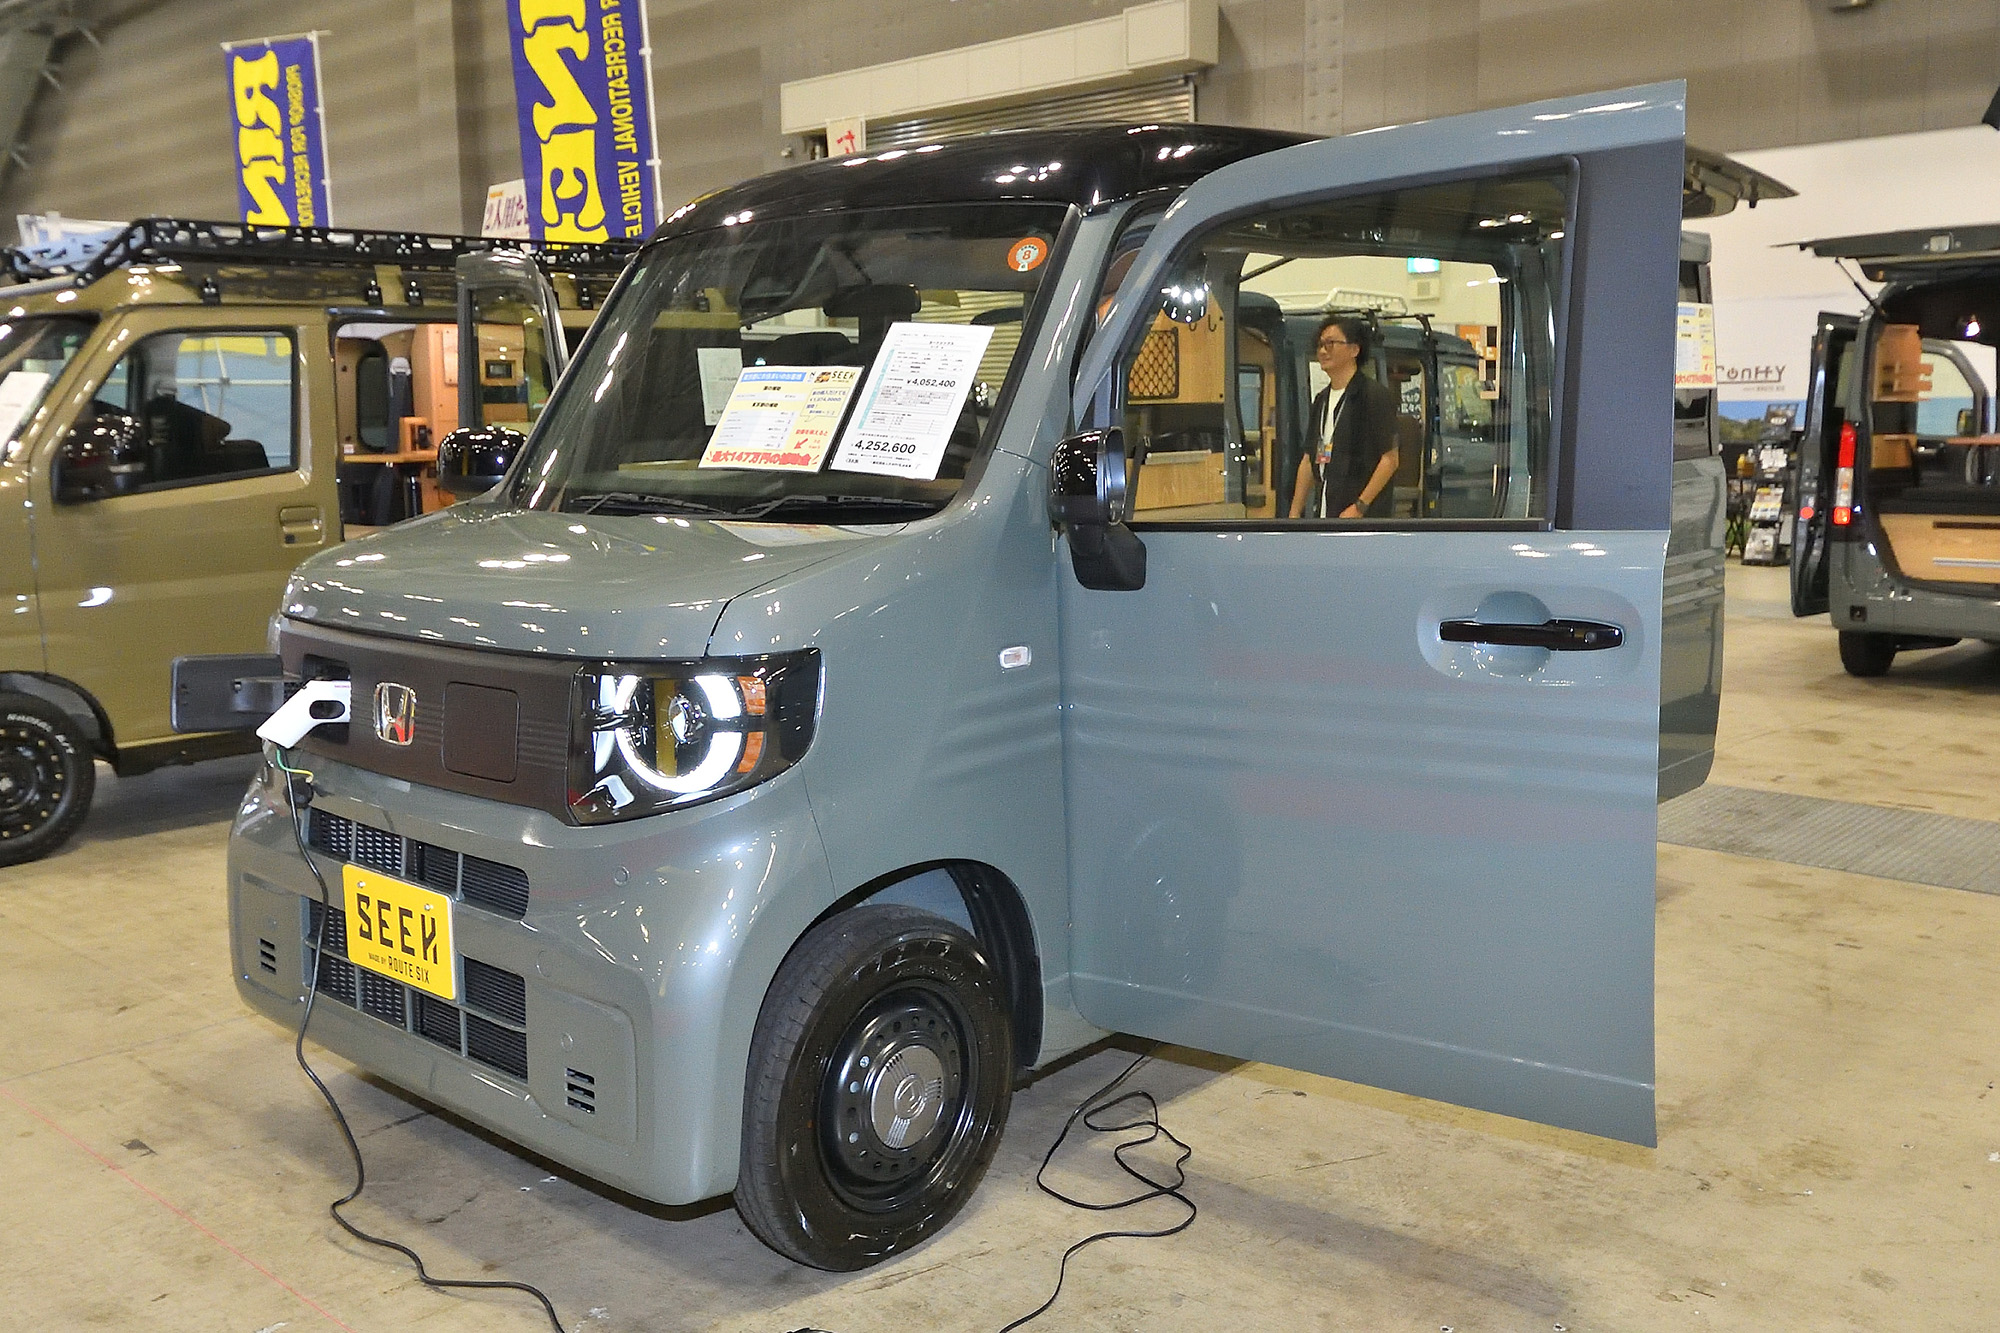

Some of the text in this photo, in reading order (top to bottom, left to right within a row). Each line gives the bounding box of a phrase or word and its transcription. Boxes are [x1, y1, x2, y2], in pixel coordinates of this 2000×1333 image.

[1022, 249, 1032, 260] 8
[831, 370, 856, 380] SEEK
[906, 378, 956, 388] ¥4,052,400
[356, 892, 439, 966] SEEK
[388, 955, 414, 979] ROUTE
[415, 965, 430, 985] SIX
